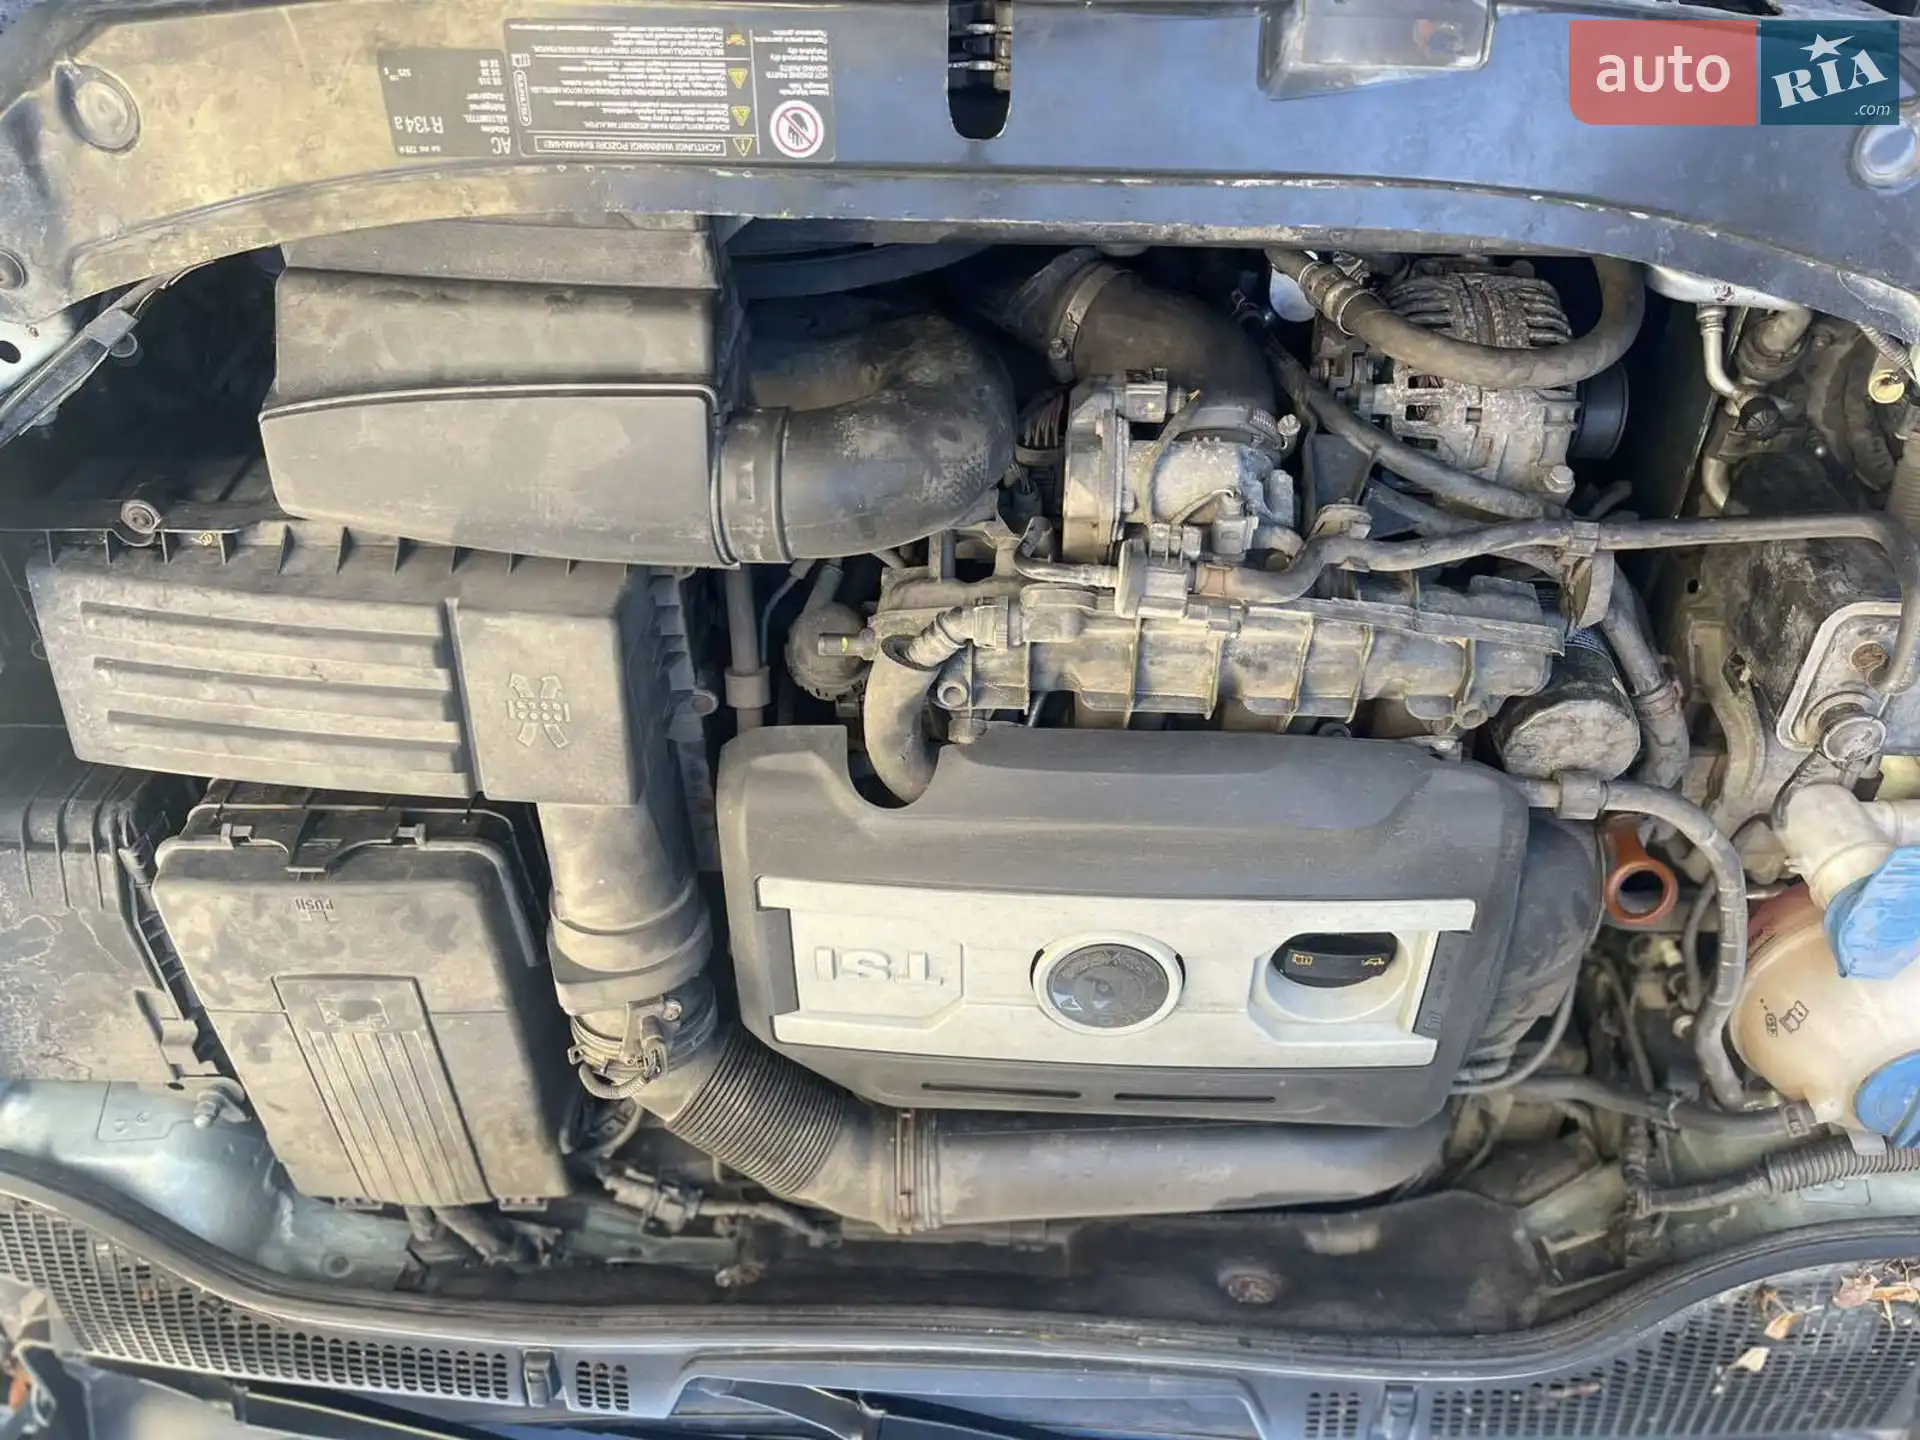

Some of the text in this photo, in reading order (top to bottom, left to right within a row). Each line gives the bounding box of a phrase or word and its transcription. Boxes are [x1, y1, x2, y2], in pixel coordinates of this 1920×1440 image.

[490, 136, 511, 155] AC
[295, 898, 335, 912] PUSH
[814, 946, 944, 987] TSI
